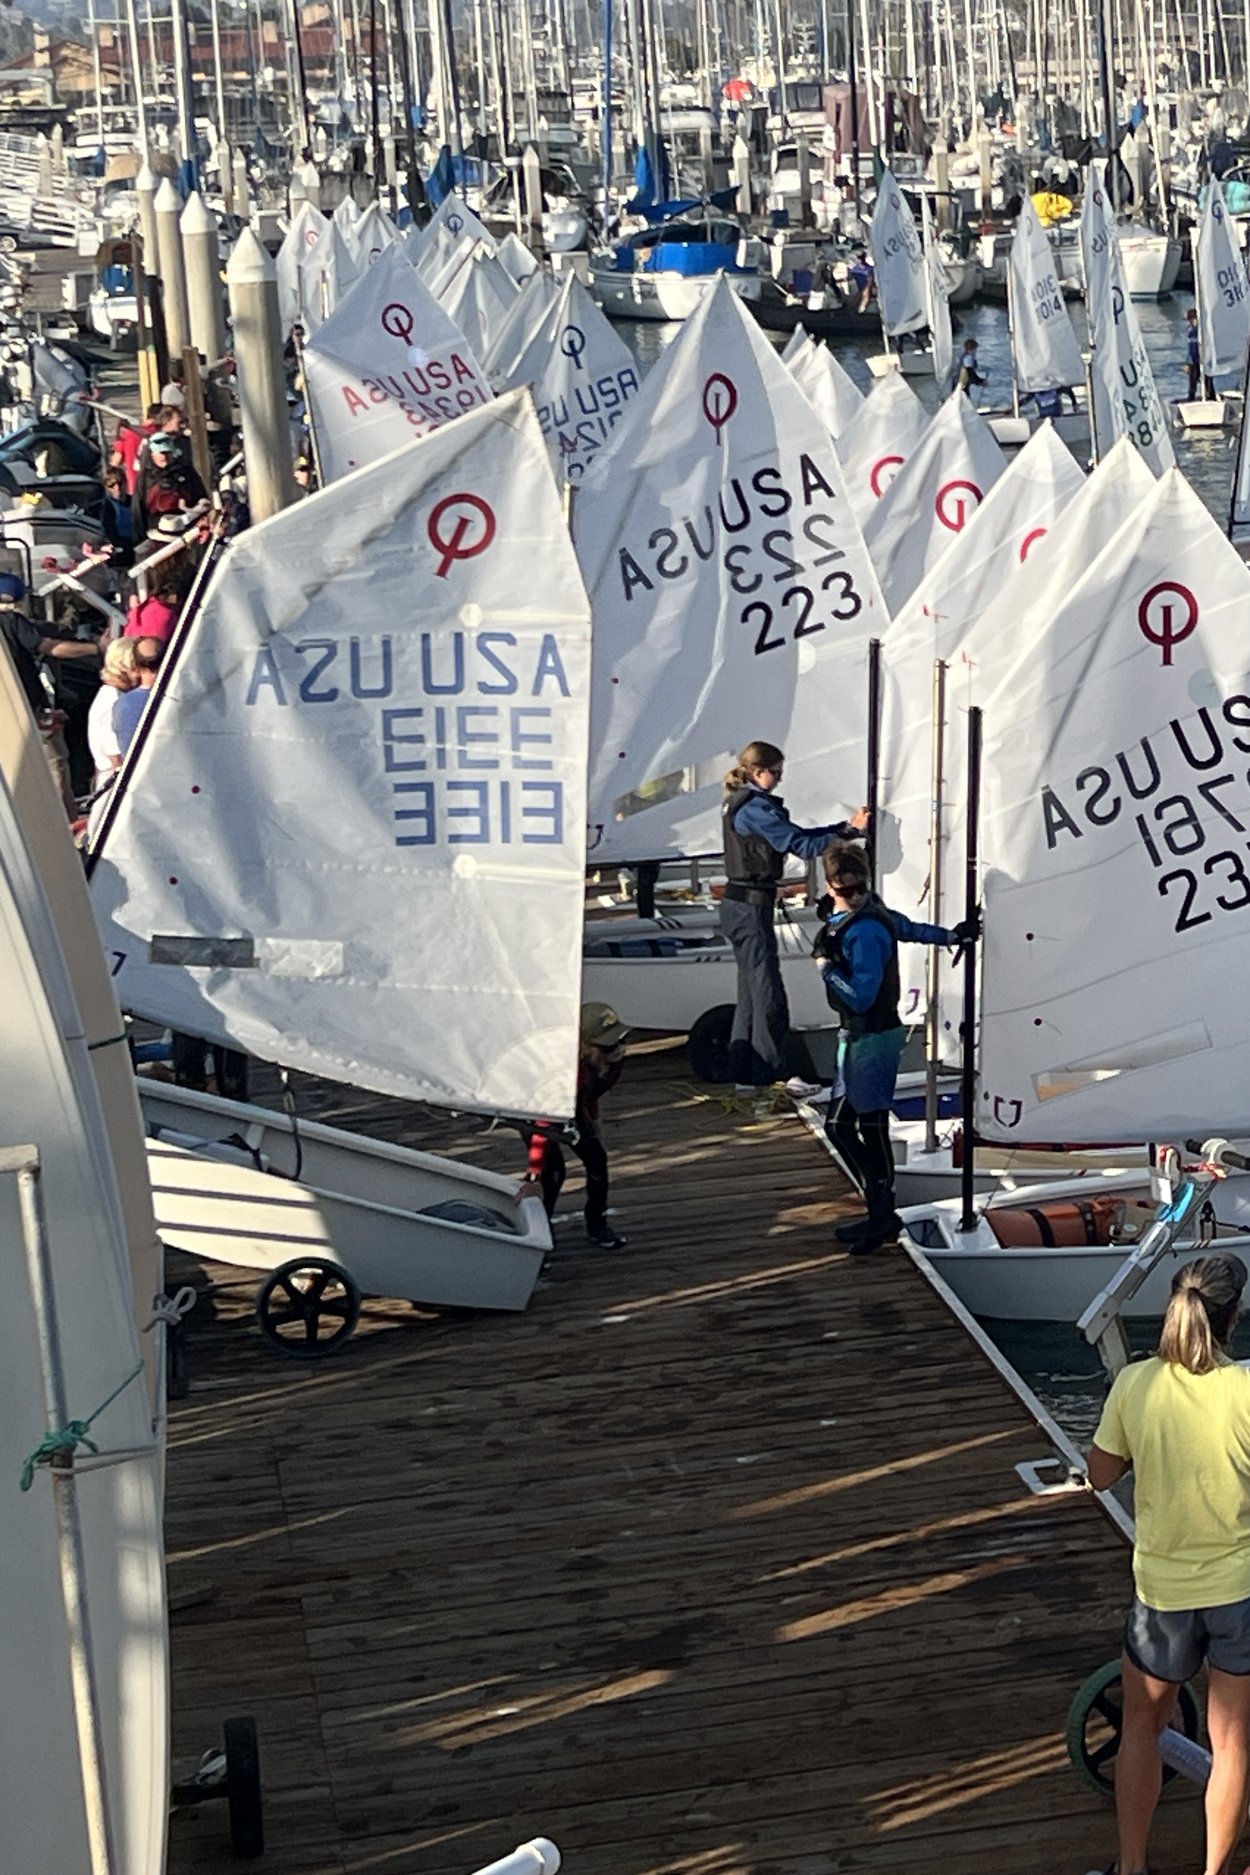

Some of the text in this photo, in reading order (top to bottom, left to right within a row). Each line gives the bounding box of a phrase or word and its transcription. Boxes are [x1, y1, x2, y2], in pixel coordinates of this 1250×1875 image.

[402, 354, 476, 396] USA
[575, 368, 639, 415] USA
[719, 454, 835, 532] USA
[741, 571, 862, 656] 223
[421, 632, 571, 698] USA
